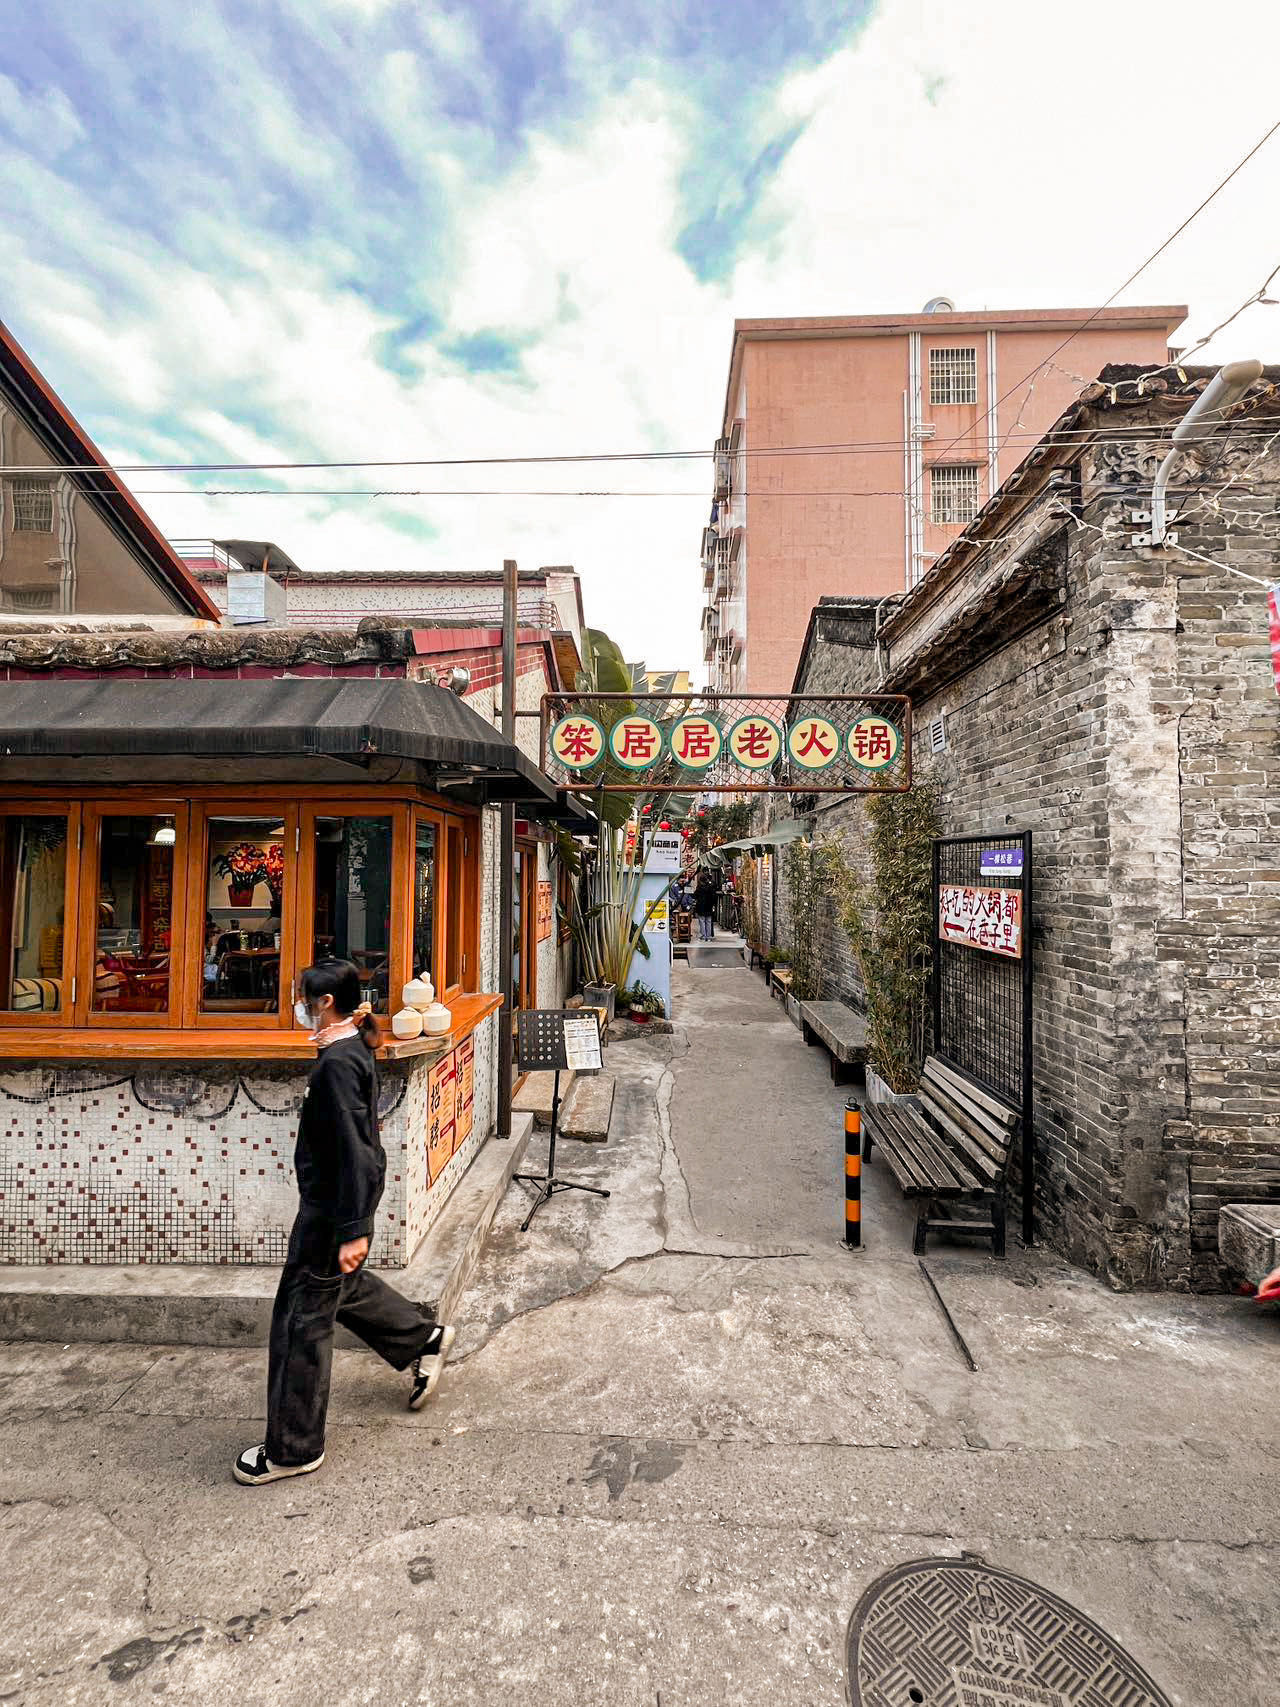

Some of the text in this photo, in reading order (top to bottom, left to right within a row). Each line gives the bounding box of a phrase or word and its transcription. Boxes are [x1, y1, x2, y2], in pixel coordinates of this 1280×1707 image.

[559, 723, 893, 762] 笨居居老火锅
[966, 917, 1016, 953] 在巷子里
[430, 1081, 441, 1151] 招聘
[980, 1627, 1015, 1646] D400
[982, 1642, 1020, 1664] 污水
